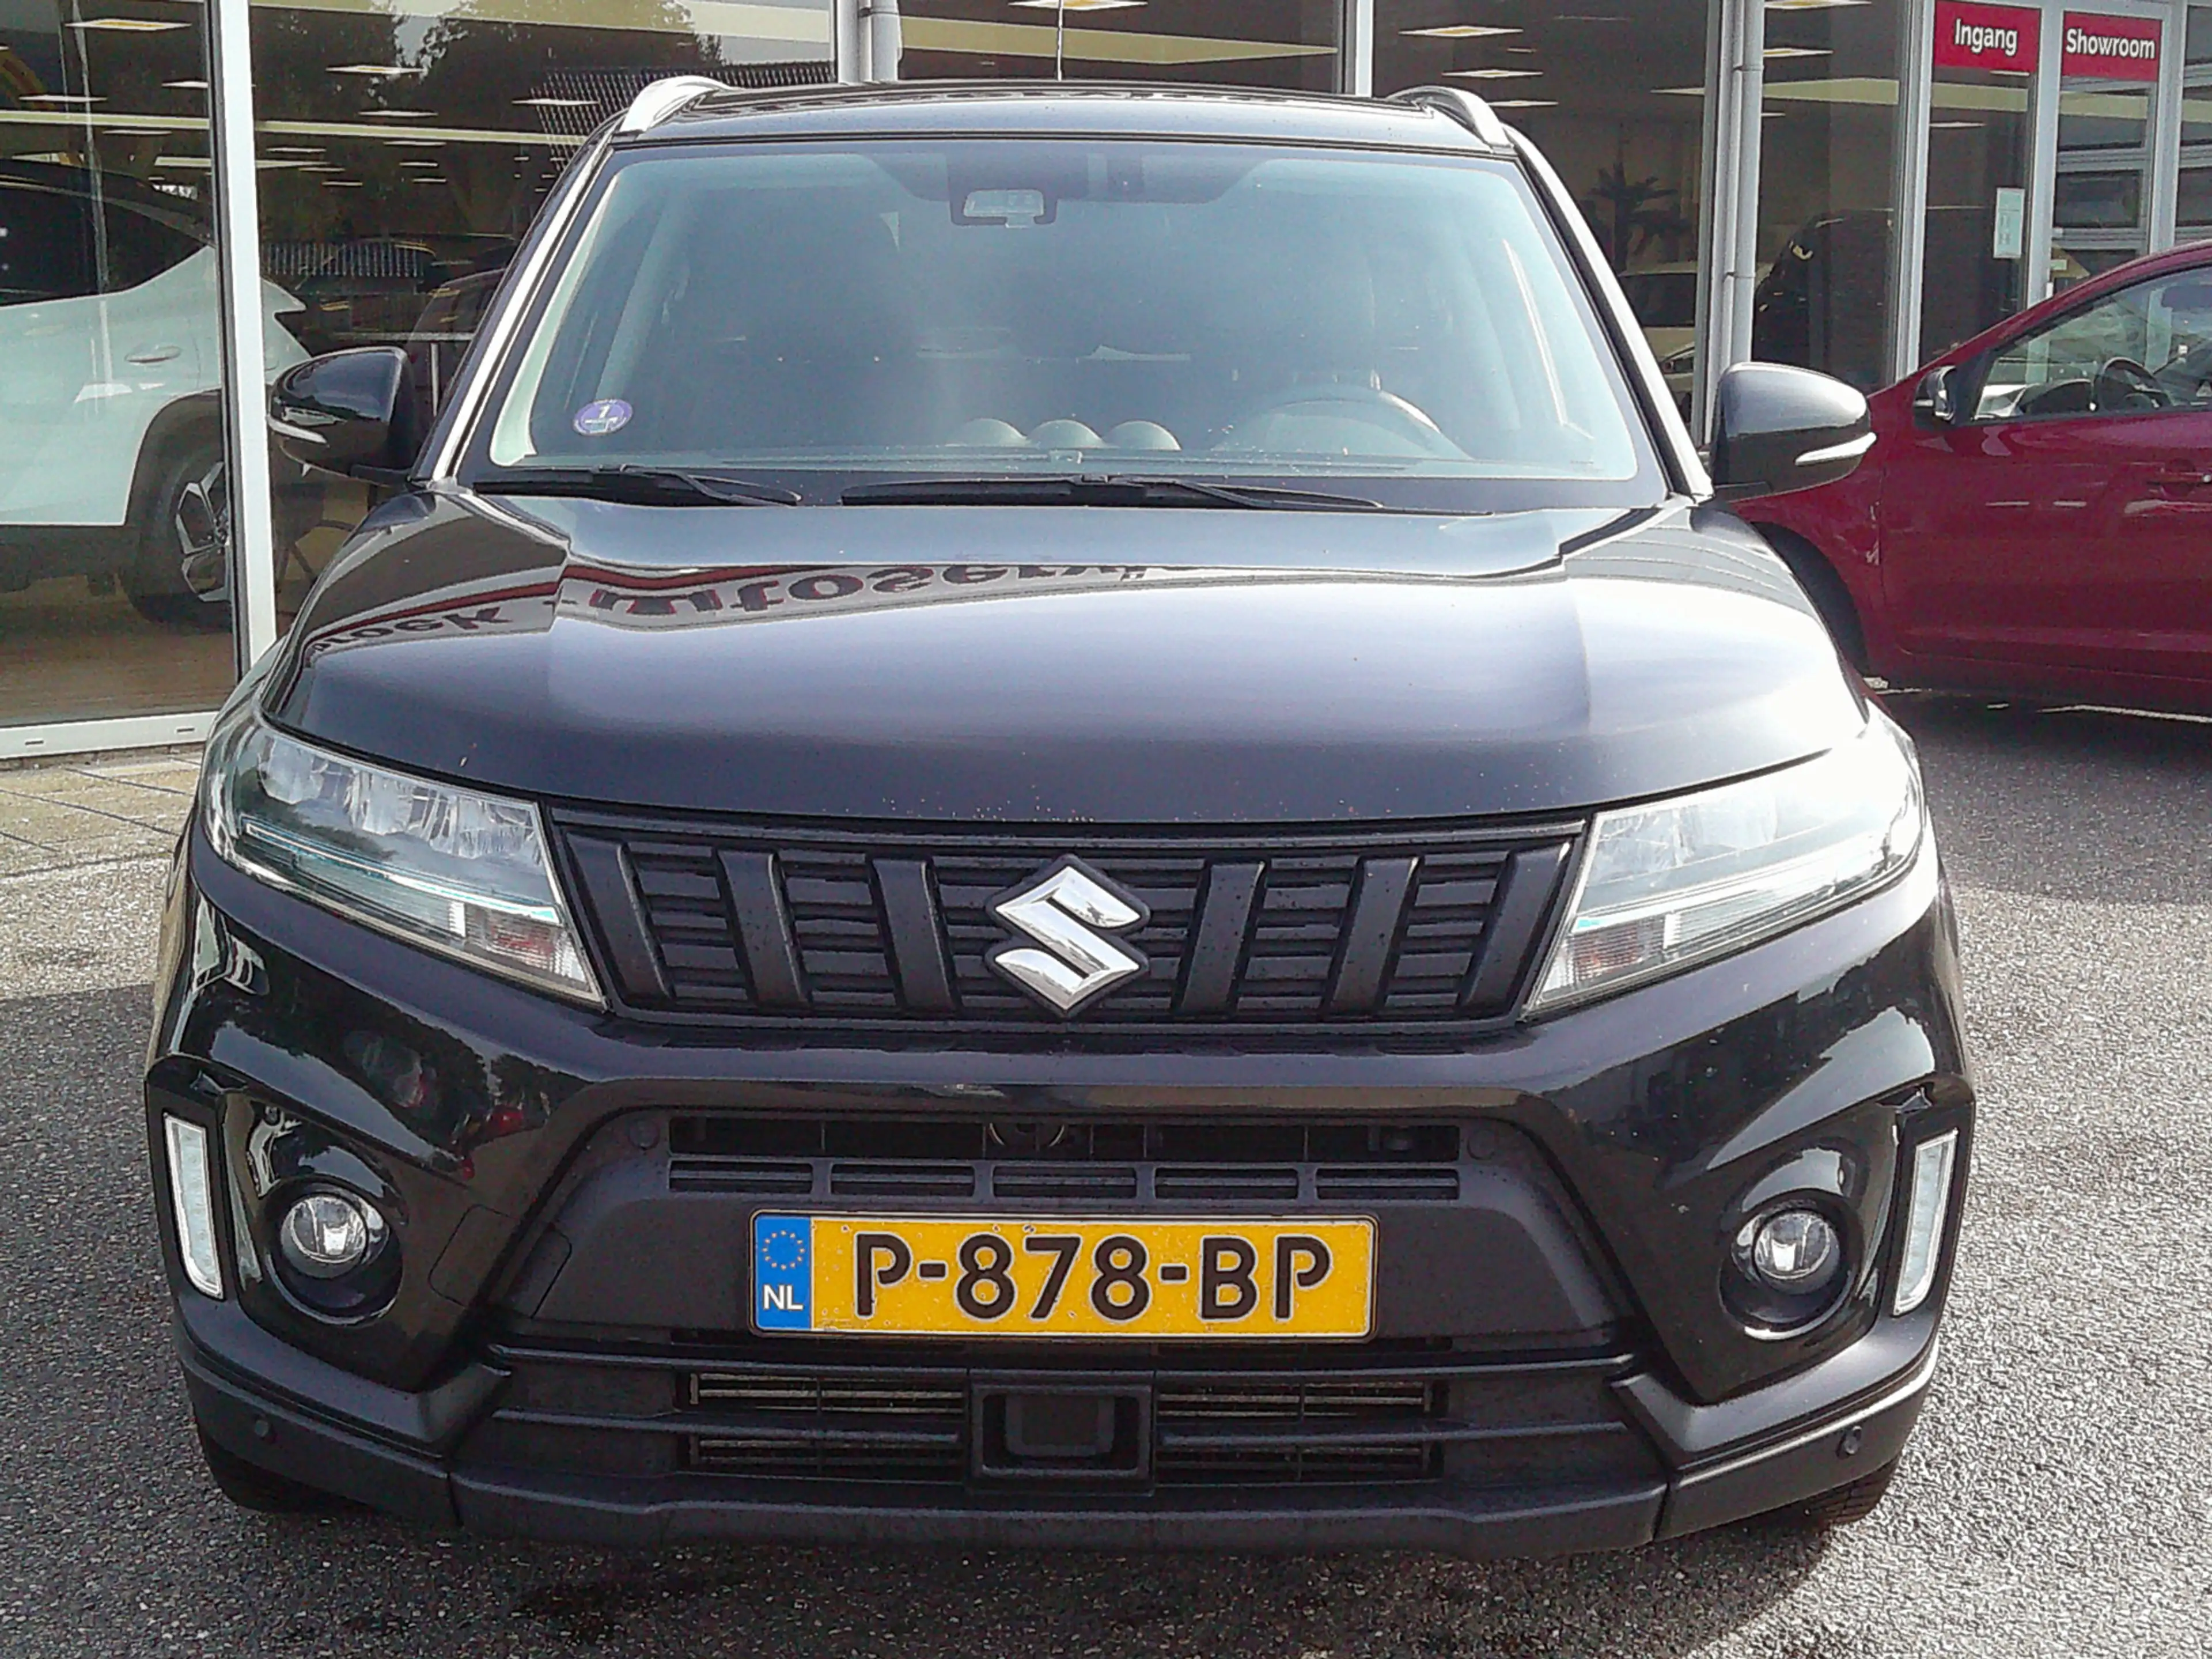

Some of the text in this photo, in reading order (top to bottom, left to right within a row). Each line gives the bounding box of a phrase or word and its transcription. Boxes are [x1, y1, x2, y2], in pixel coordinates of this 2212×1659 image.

[1954, 18, 2018, 57] Ingang
[2066, 28, 2157, 60] Showroom
[762, 1233, 1333, 1321] NL P-878-BP
